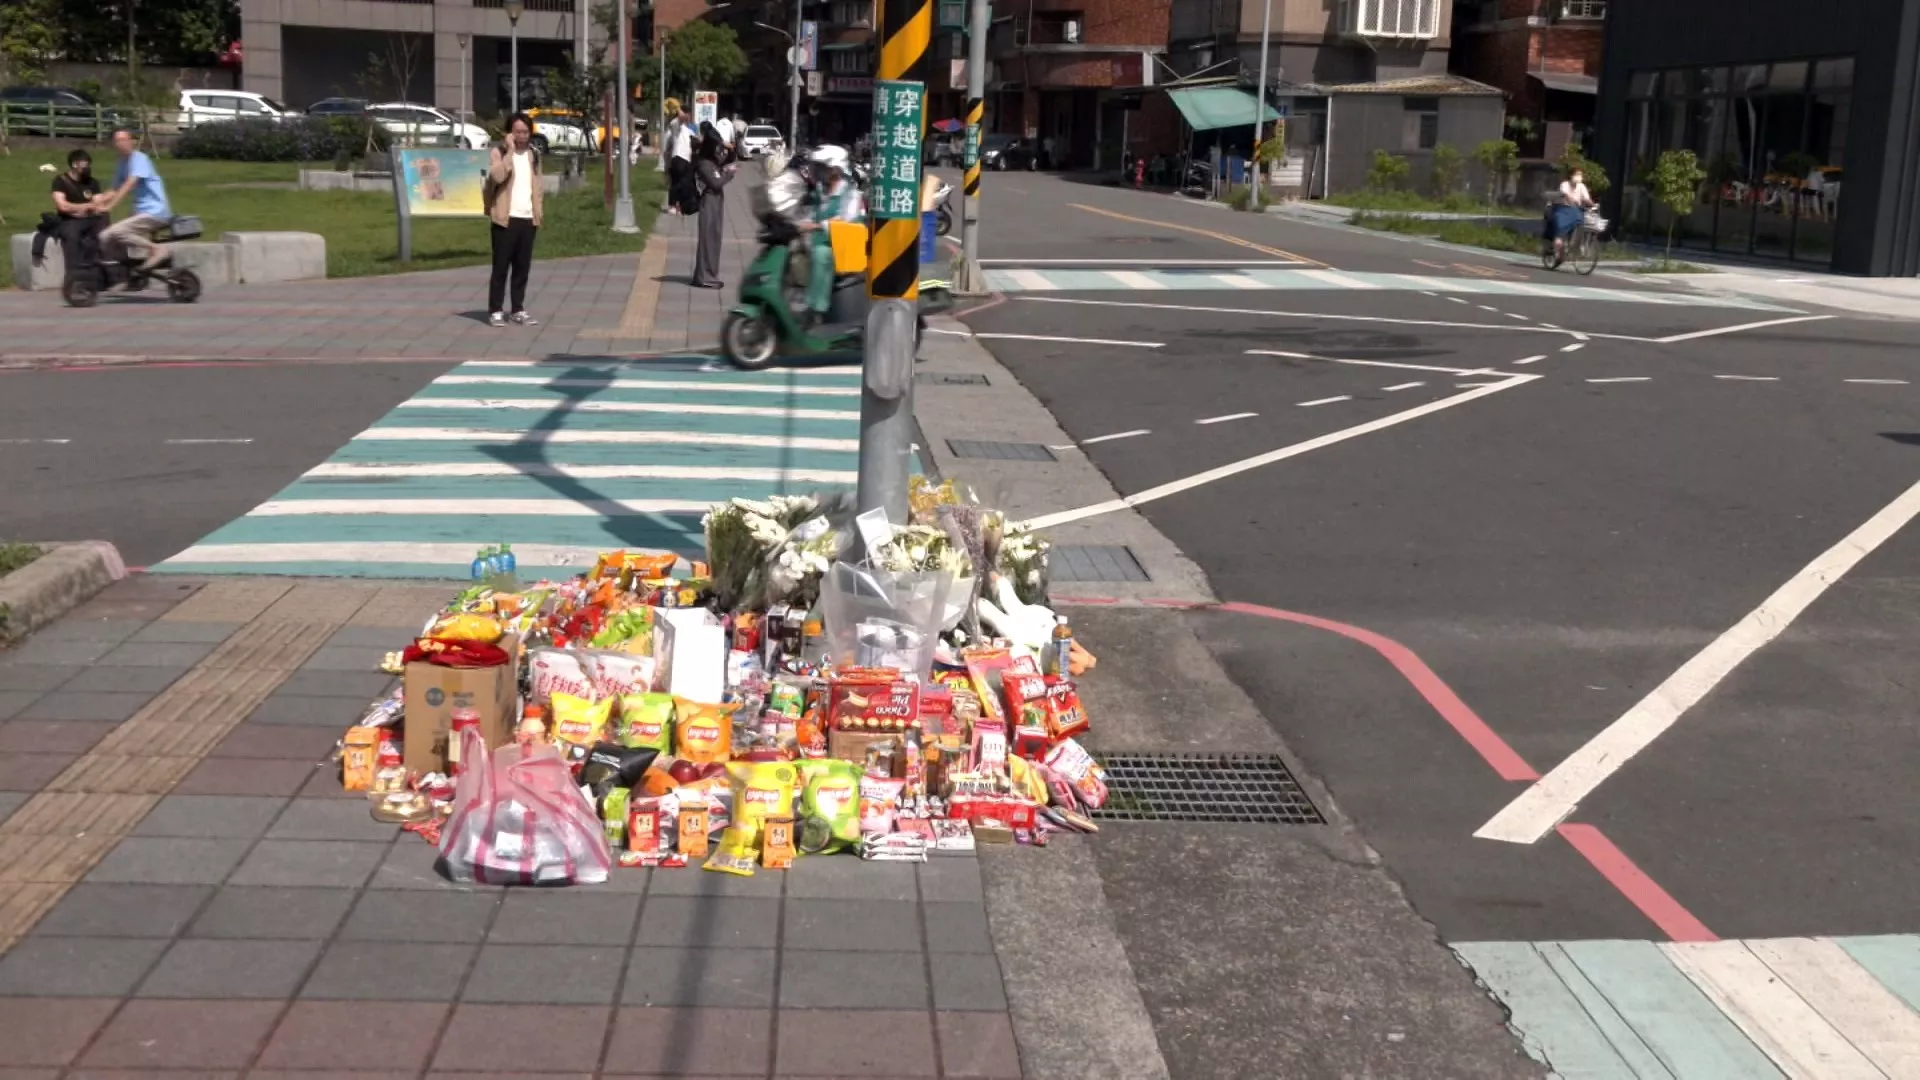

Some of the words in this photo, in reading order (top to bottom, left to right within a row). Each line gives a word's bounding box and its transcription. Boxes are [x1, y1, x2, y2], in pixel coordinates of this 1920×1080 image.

[890, 88, 919, 213] 穿越道路
[891, 694, 910, 706] Pie
[875, 705, 910, 717] Choco
